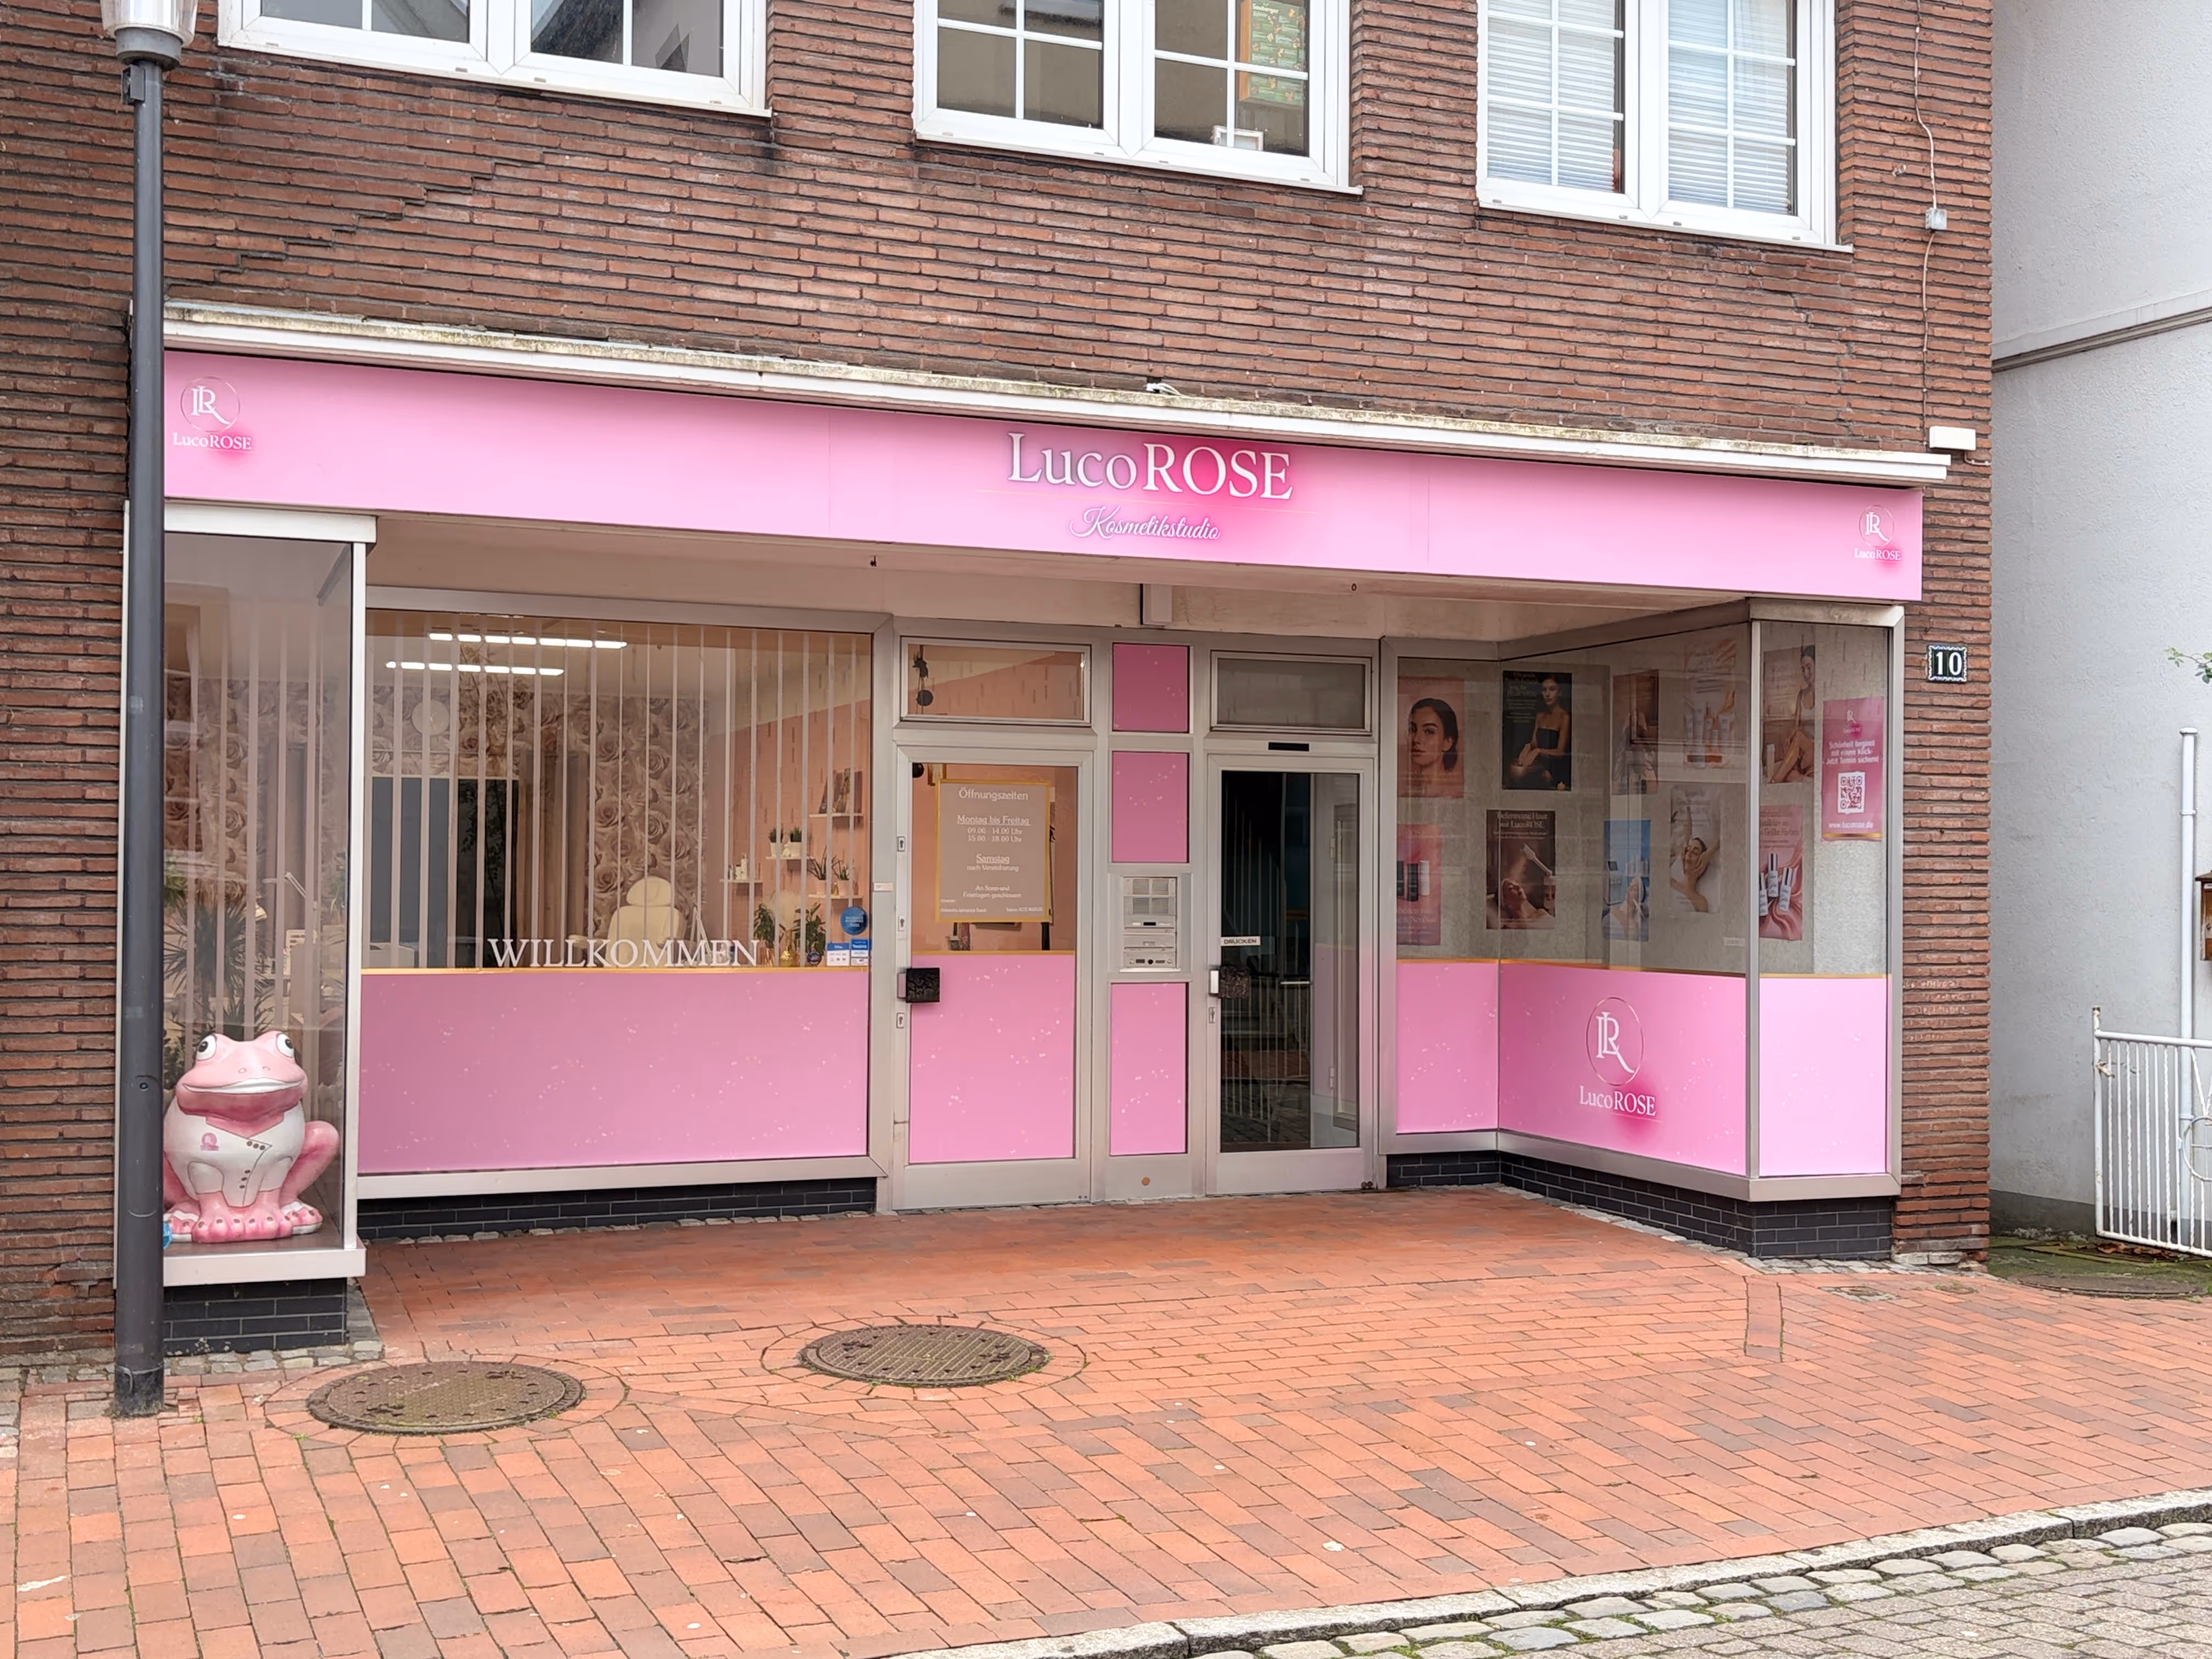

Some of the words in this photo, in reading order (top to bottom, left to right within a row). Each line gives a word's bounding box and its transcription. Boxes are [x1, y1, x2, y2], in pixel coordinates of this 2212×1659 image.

[173, 432, 252, 450] LucoROSE
[1007, 432, 1294, 500] LucoROSE
[1070, 505, 1221, 540] Kosmetikstudio
[1854, 548, 1901, 561] LucoROSE
[1936, 651, 1962, 676] 10
[958, 787, 1028, 802] Öffnungszeiten
[957, 815, 988, 825] Montag
[989, 815, 1001, 823] bis
[1003, 815, 1030, 826] Freitag
[976, 853, 1010, 865] Samstag
[488, 938, 759, 968] WILLKOMMEN
[1579, 1085, 1656, 1116] LucoROSE
